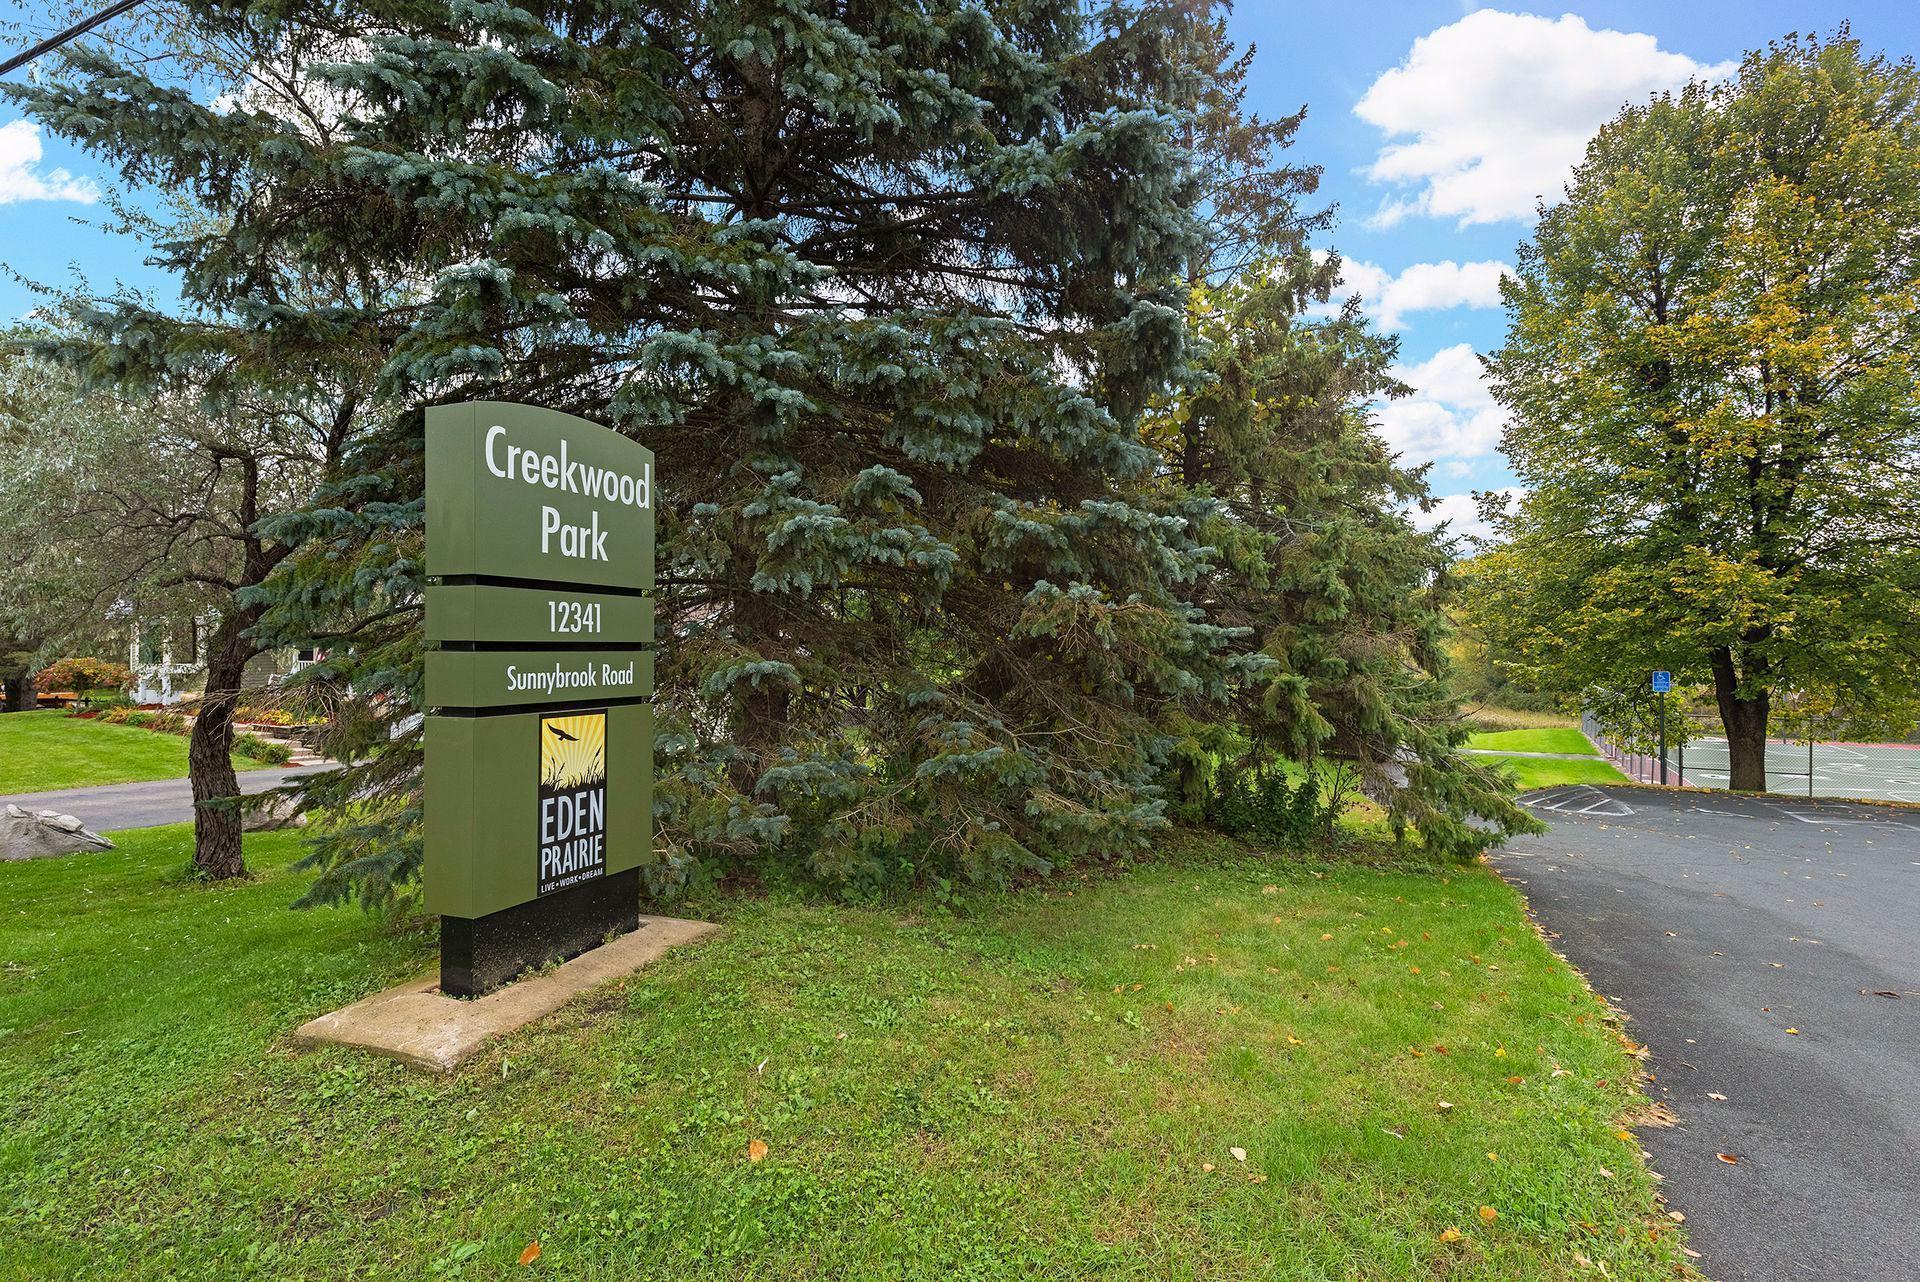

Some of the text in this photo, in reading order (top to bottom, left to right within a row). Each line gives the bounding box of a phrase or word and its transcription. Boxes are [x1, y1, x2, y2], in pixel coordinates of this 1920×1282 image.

[485, 425, 650, 509] Creekwood
[541, 506, 608, 562] Park
[549, 601, 601, 633] 12341
[507, 661, 633, 694] Sunnybrook Road
[542, 788, 603, 844] EDEN
[541, 834, 602, 880] PRAIRIE
[541, 868, 603, 893] LIVE WORK DREAM
